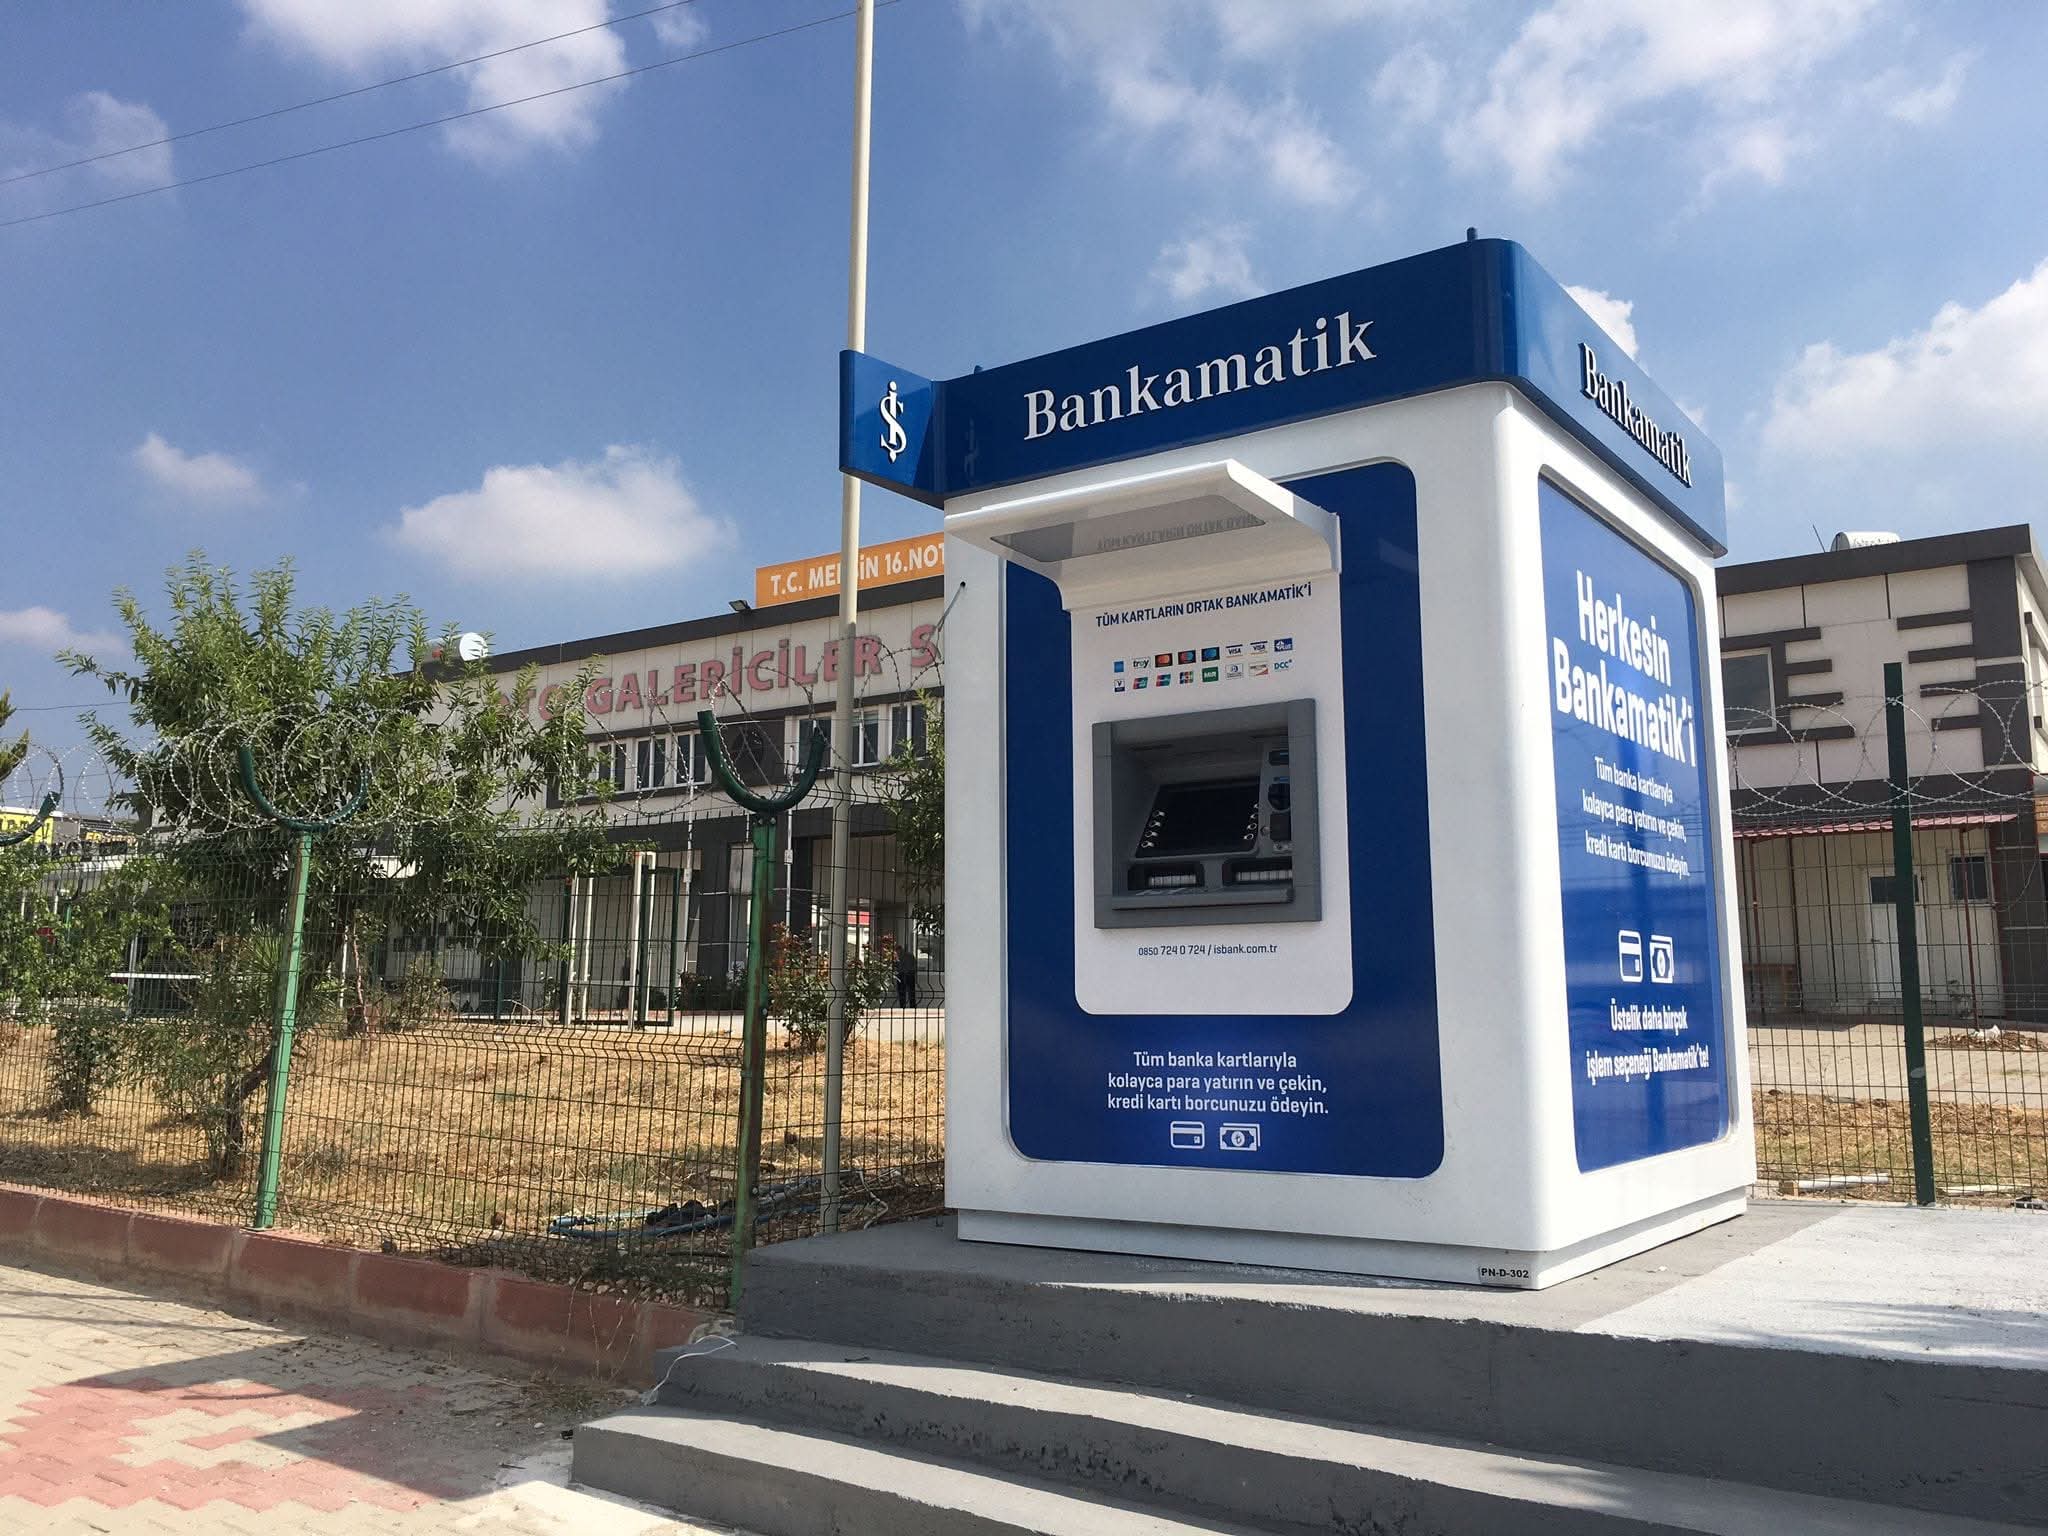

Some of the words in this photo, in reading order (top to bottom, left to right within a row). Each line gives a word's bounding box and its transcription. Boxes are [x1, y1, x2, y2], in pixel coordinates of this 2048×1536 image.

[1023, 311, 1377, 440] Bankamatik
[1578, 342, 1693, 489] Bankamatik
[771, 571, 803, 596] T.C.
[808, 556, 879, 590] MEİN
[1095, 612, 1119, 627] TÜM
[1121, 603, 1184, 624] KARTLARIN
[1186, 598, 1224, 613] ORTAK
[1576, 568, 1671, 687] Herkesin
[587, 637, 885, 715] GALERİCİLER
[1553, 637, 1696, 768] Bankamatik'i
[1595, 756, 1615, 781] Tüm
[1614, 762, 1637, 792] banka
[1582, 789, 1614, 822] kolayca
[1615, 804, 1633, 825] para
[1585, 830, 1607, 856] kredi
[1607, 837, 1626, 861] kartı
[1138, 946, 1158, 956] 0850
[1161, 945, 1178, 955] 724
[1179, 945, 1186, 955] 0
[1188, 945, 1206, 955] 724
[1213, 943, 1278, 955] isbank.com.tr
[1610, 998, 1642, 1031] Üstelik
[1642, 1004, 1663, 1030] daha
[1662, 1005, 1688, 1036] birçok
[1133, 1051, 1165, 1067] Tüm
[1168, 1052, 1214, 1068] banka
[1217, 1051, 1297, 1072] kartlarıyla
[1586, 1050, 1613, 1086] işlem
[1614, 1047, 1652, 1082] seçeneği
[1108, 1072, 1163, 1092] kolayca
[1166, 1076, 1200, 1092] para
[1203, 1075, 1254, 1093] yatırın
[1257, 1077, 1275, 1090] ve
[1279, 1075, 1327, 1095] çekin,
[1107, 1094, 1144, 1110] kredi
[1147, 1094, 1181, 1111] kartı
[1184, 1095, 1266, 1113] borcunuzu
[1270, 1095, 1329, 1117] ödeyin.
[1481, 1268, 1529, 1279] PN-D-302
